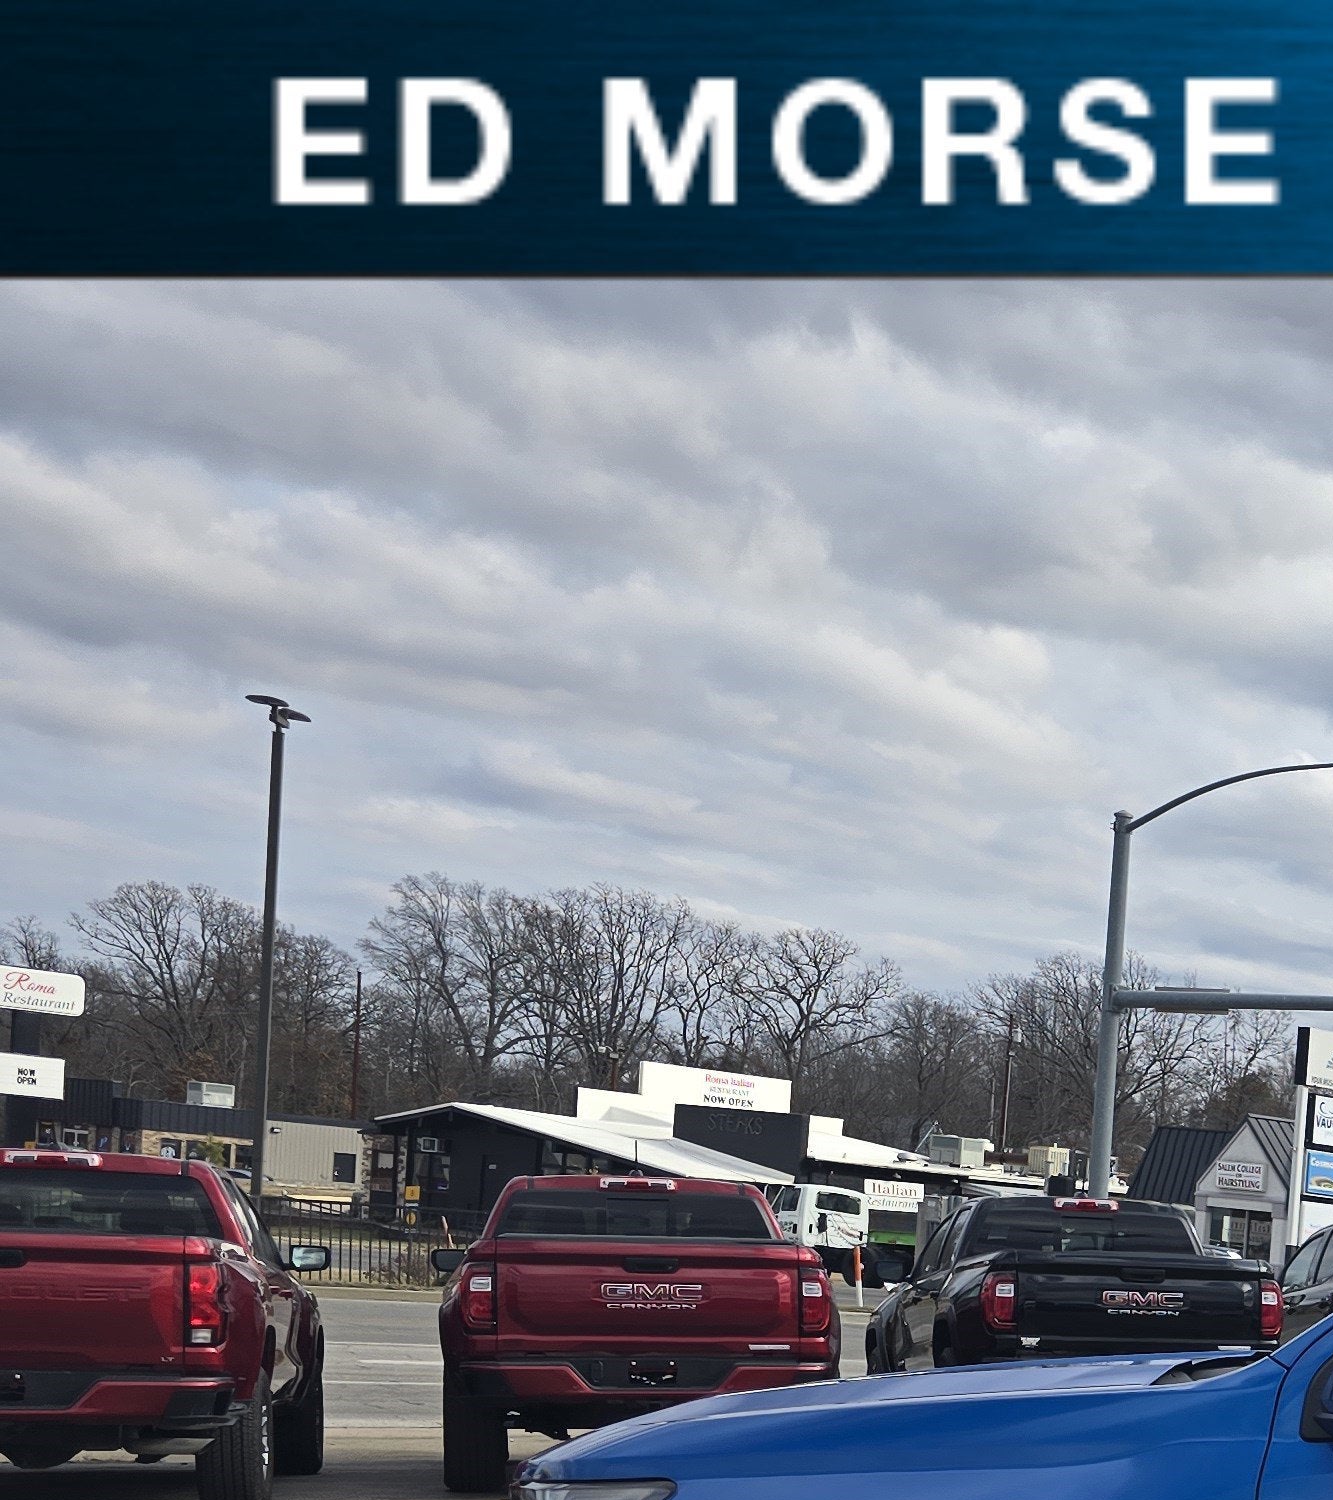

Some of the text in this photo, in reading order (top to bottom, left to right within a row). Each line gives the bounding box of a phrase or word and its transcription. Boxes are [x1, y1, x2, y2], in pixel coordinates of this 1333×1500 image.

[4, 971, 56, 994] Roma
[3, 992, 75, 1010] Restaurant
[17, 1067, 35, 1077] NOW
[17, 1077, 36, 1086] OPEN
[705, 1073, 755, 1088] Roma Italian
[703, 1094, 754, 1108] NOW OPEN
[707, 1113, 763, 1135] STEAKS
[1218, 1163, 1261, 1175] SALEM COLLEGE
[871, 1182, 917, 1197] Italian
[1218, 1177, 1260, 1189] HAIRSTYLING
[601, 1283, 702, 1301] GMC
[1102, 1290, 1184, 1308] GMC
[1107, 1308, 1180, 1317] CANYON
